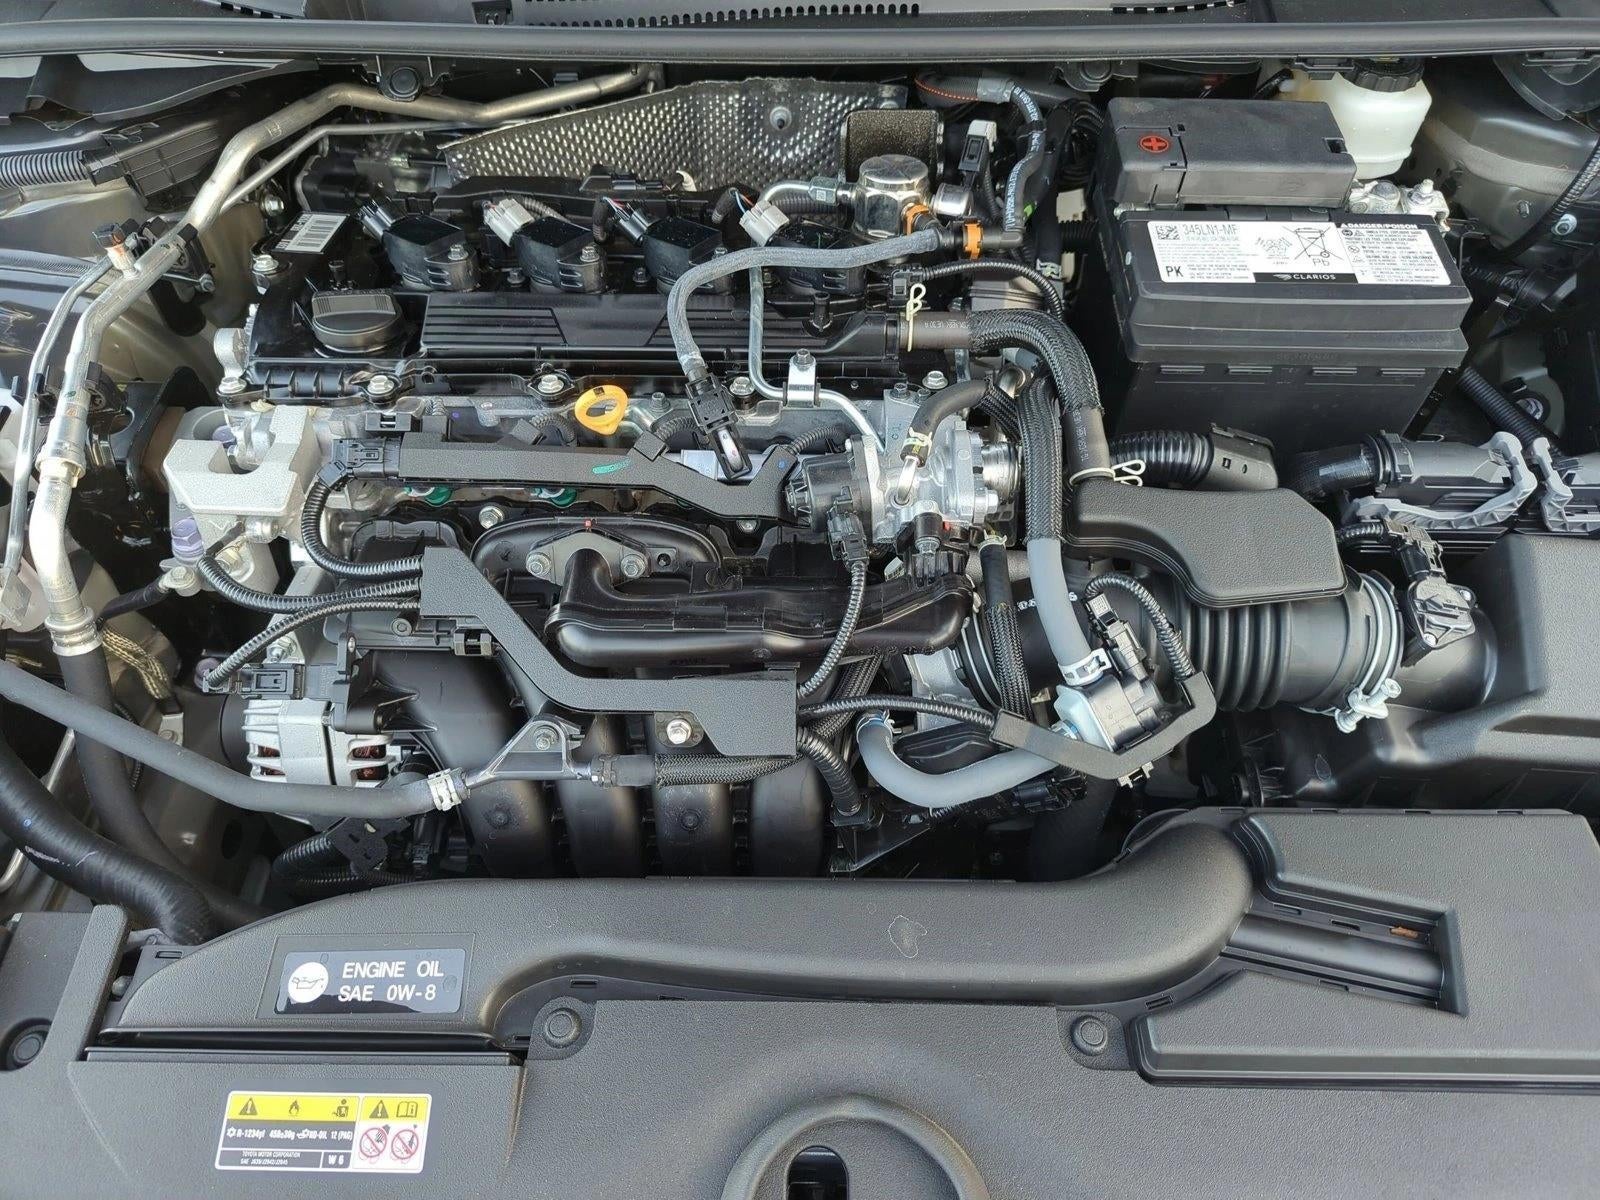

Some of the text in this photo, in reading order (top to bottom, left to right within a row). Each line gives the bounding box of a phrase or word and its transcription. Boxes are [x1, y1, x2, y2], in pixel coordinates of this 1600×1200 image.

[1182, 224, 1238, 236] 345LN1-MF
[1312, 257, 1331, 267] Pb
[1165, 265, 1184, 278] PK
[1293, 273, 1337, 281] CLARIOS
[342, 960, 444, 979] ENGINE OIL
[338, 983, 436, 1002] SAE 0W-8
[236, 1129, 266, 1140] R-1234yf
[330, 1130, 338, 1140] 12
[328, 1154, 345, 1165] W 6
